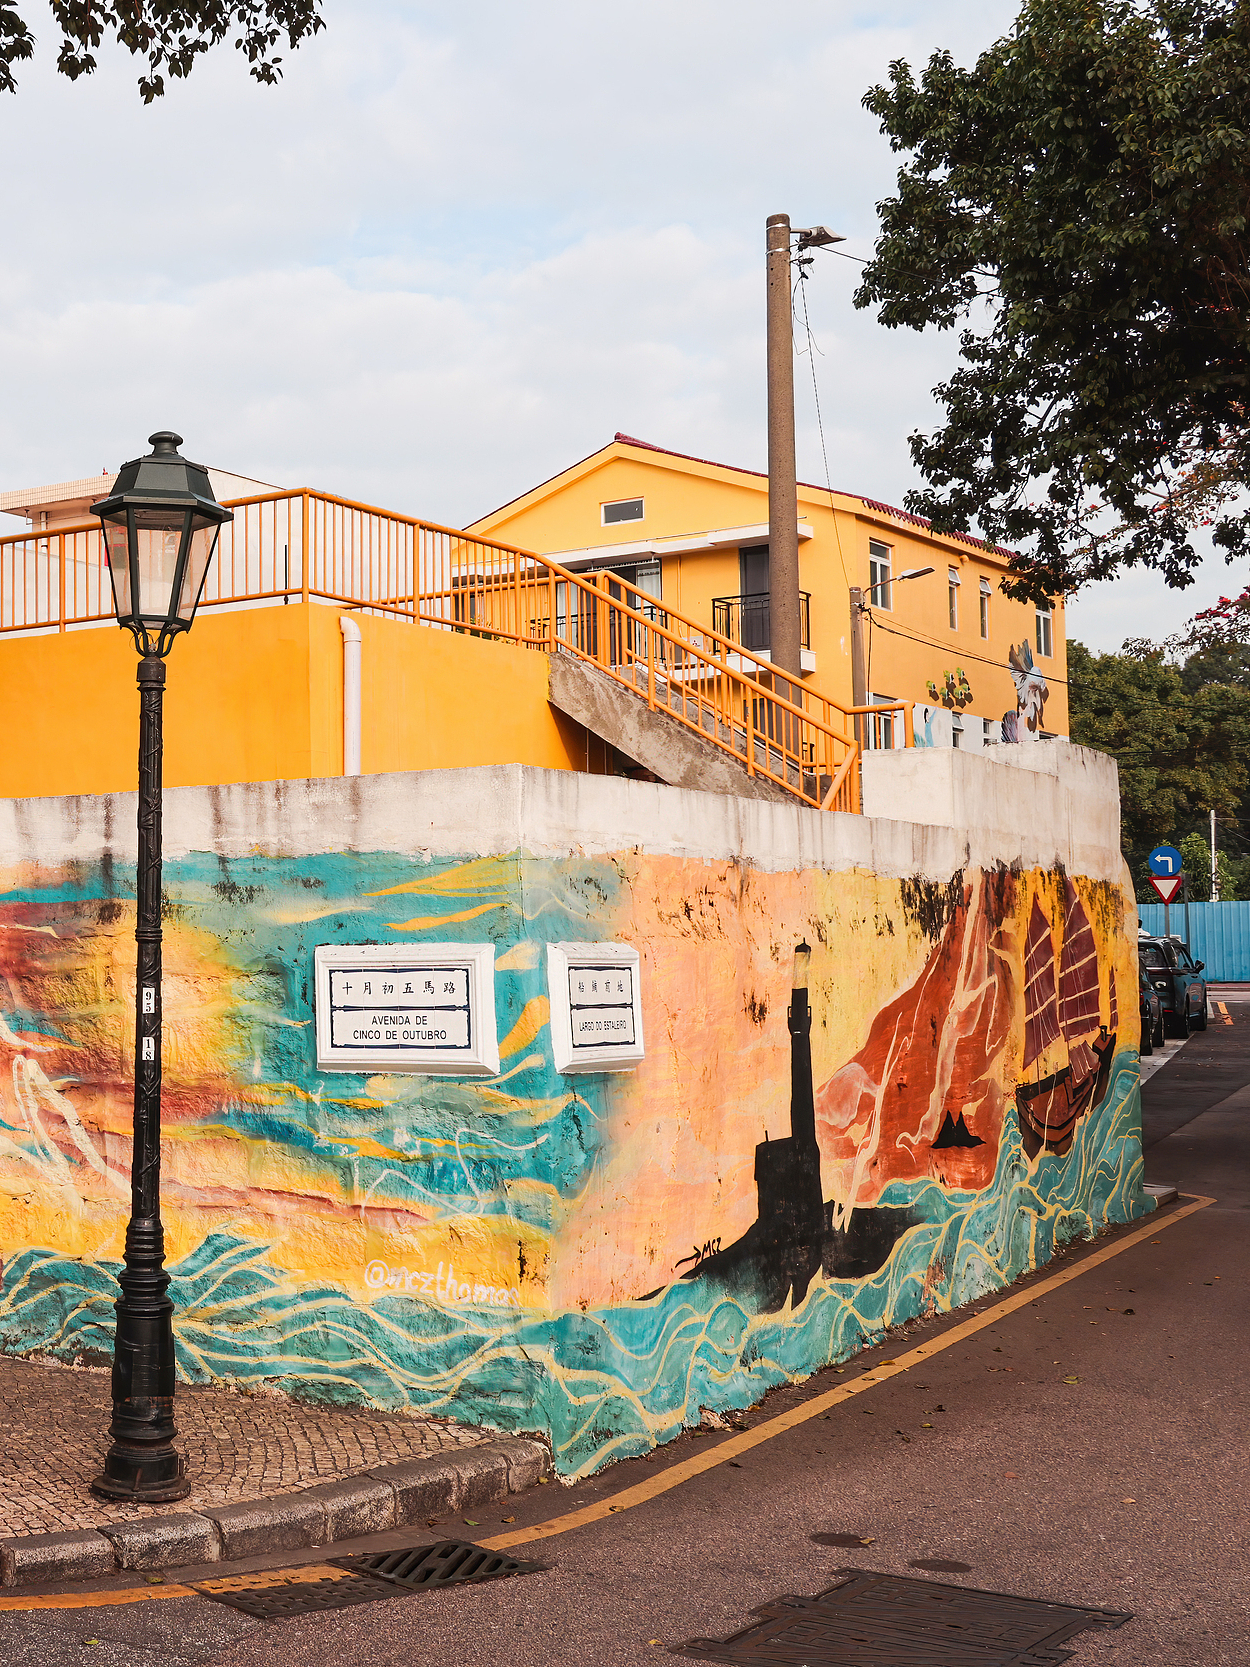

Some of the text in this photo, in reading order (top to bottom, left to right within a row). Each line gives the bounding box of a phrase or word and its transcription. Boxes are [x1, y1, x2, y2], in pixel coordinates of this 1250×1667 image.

[342, 980, 456, 995] 十月初五馬路
[371, 1015, 428, 1025] AVENIDA DE
[579, 1020, 626, 1031] LARGO DO ESTALEIRO
[353, 1030, 447, 1040] CINCO DE OUTUBRO
